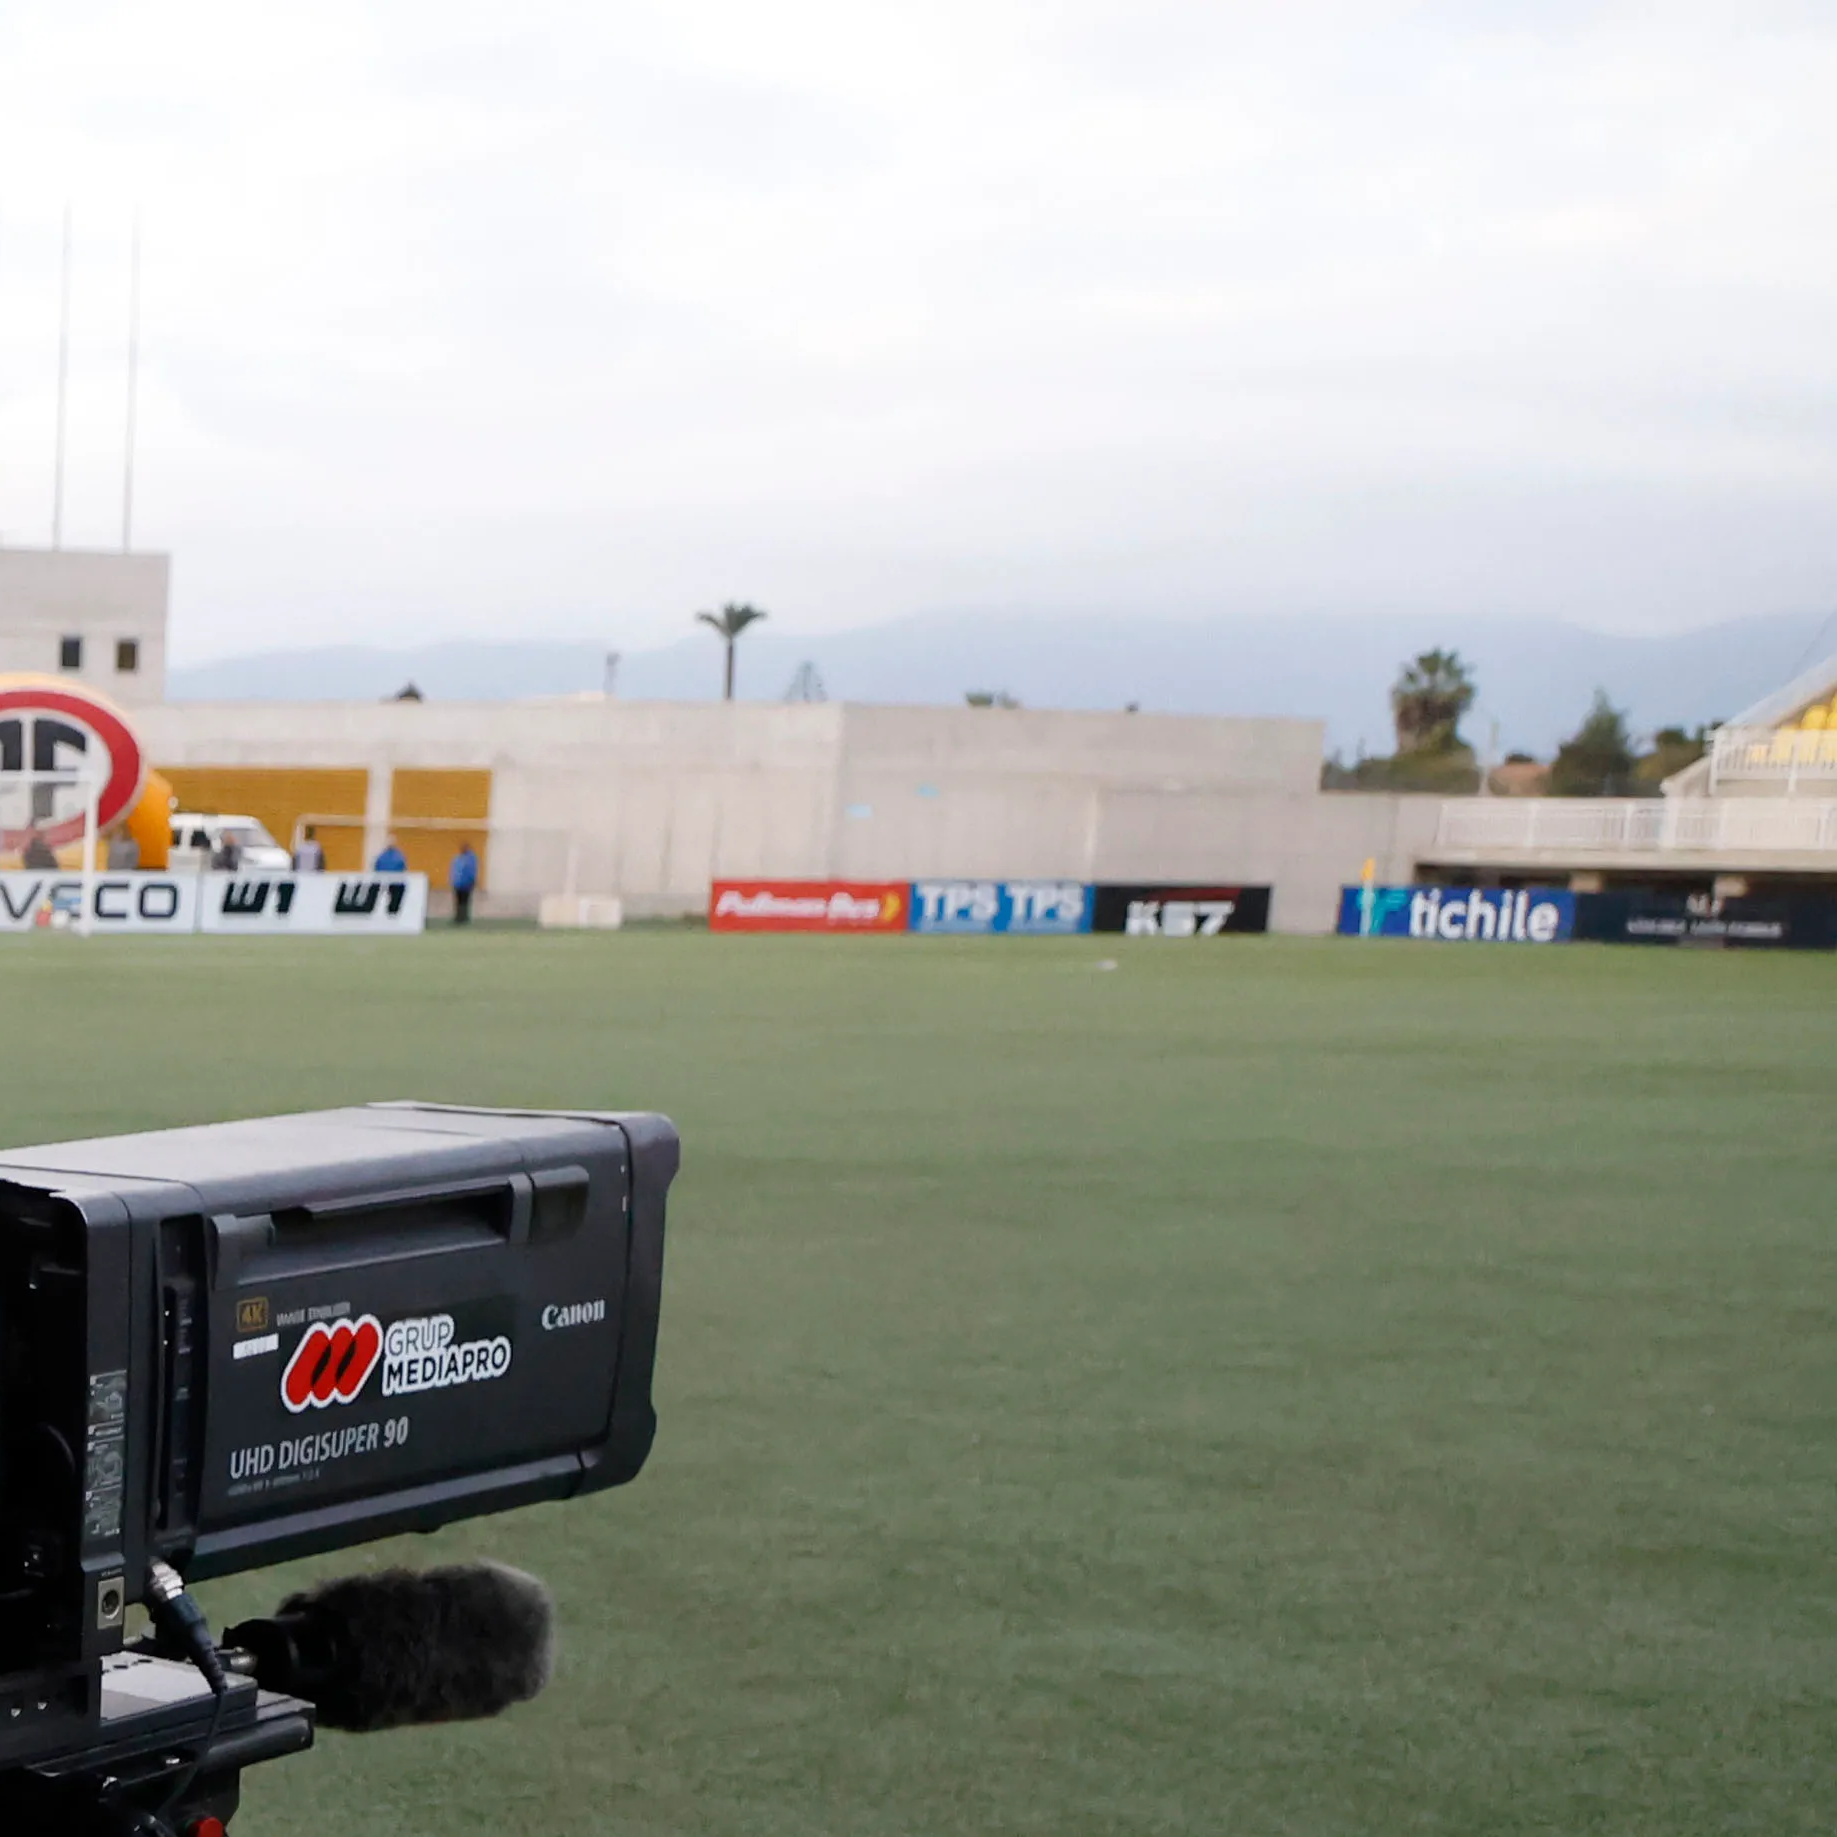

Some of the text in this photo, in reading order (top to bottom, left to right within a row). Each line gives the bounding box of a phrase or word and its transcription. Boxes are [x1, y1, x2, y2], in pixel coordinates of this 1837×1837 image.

[542, 1298, 606, 1331] Canon
[387, 1320, 452, 1358] GRUP
[385, 1343, 507, 1389] MEDIAPRO
[230, 1415, 410, 1480] UHD DIGISUPER 90
